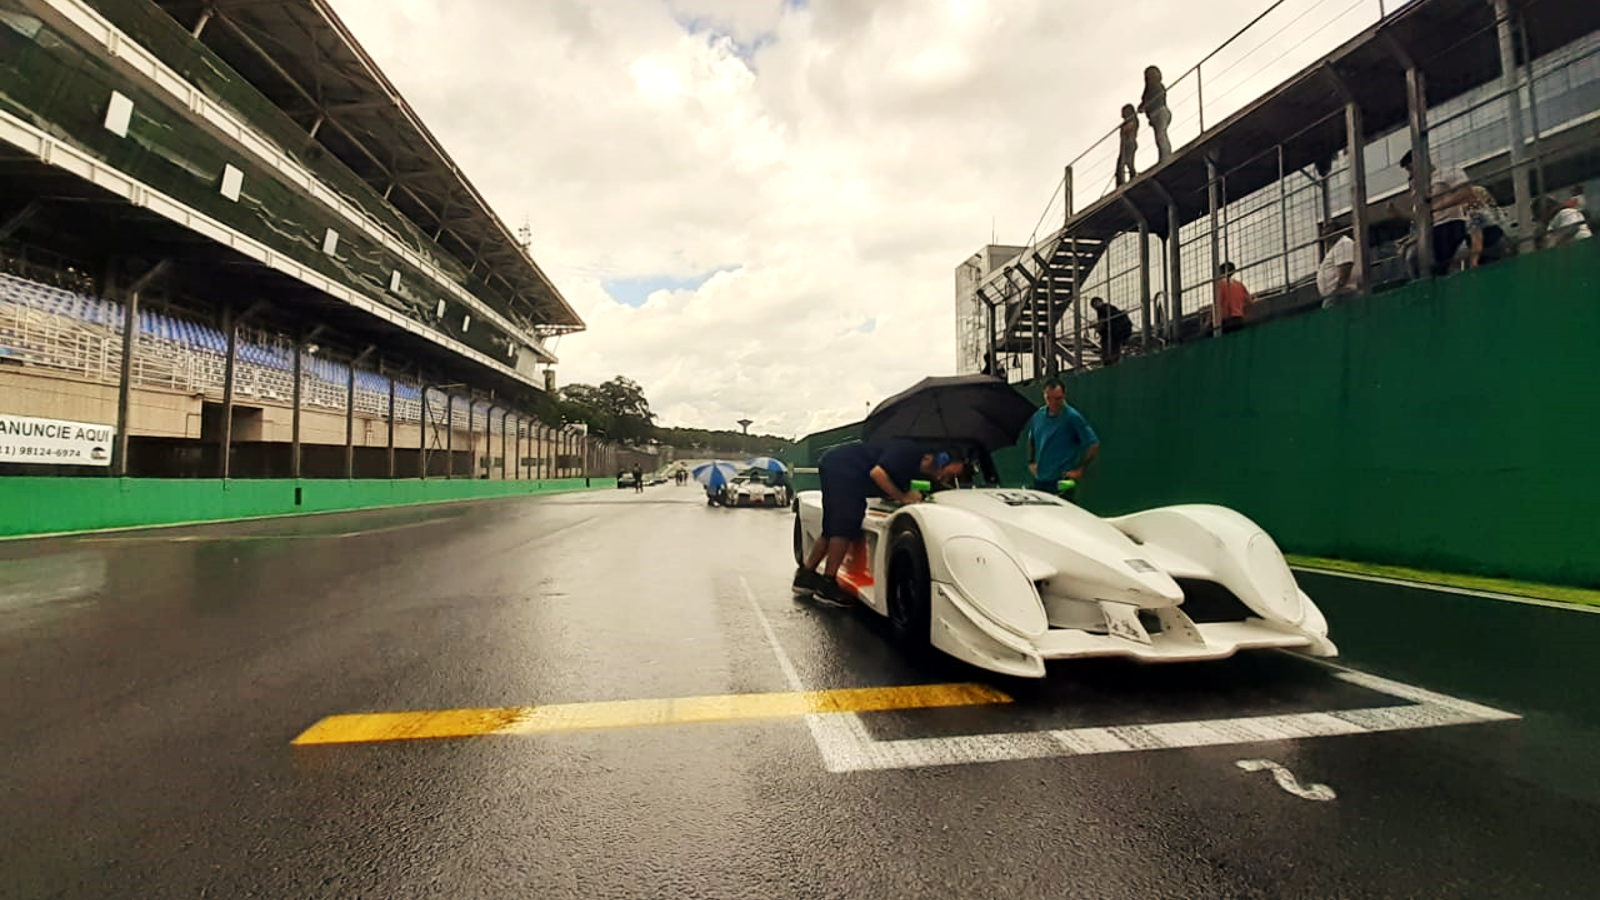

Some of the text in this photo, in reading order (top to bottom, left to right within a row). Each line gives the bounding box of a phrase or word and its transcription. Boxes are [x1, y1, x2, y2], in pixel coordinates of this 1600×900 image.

[0, 420, 110, 442] ANUNCIE AQUI
[19, 446, 81, 457] 98124-6974
